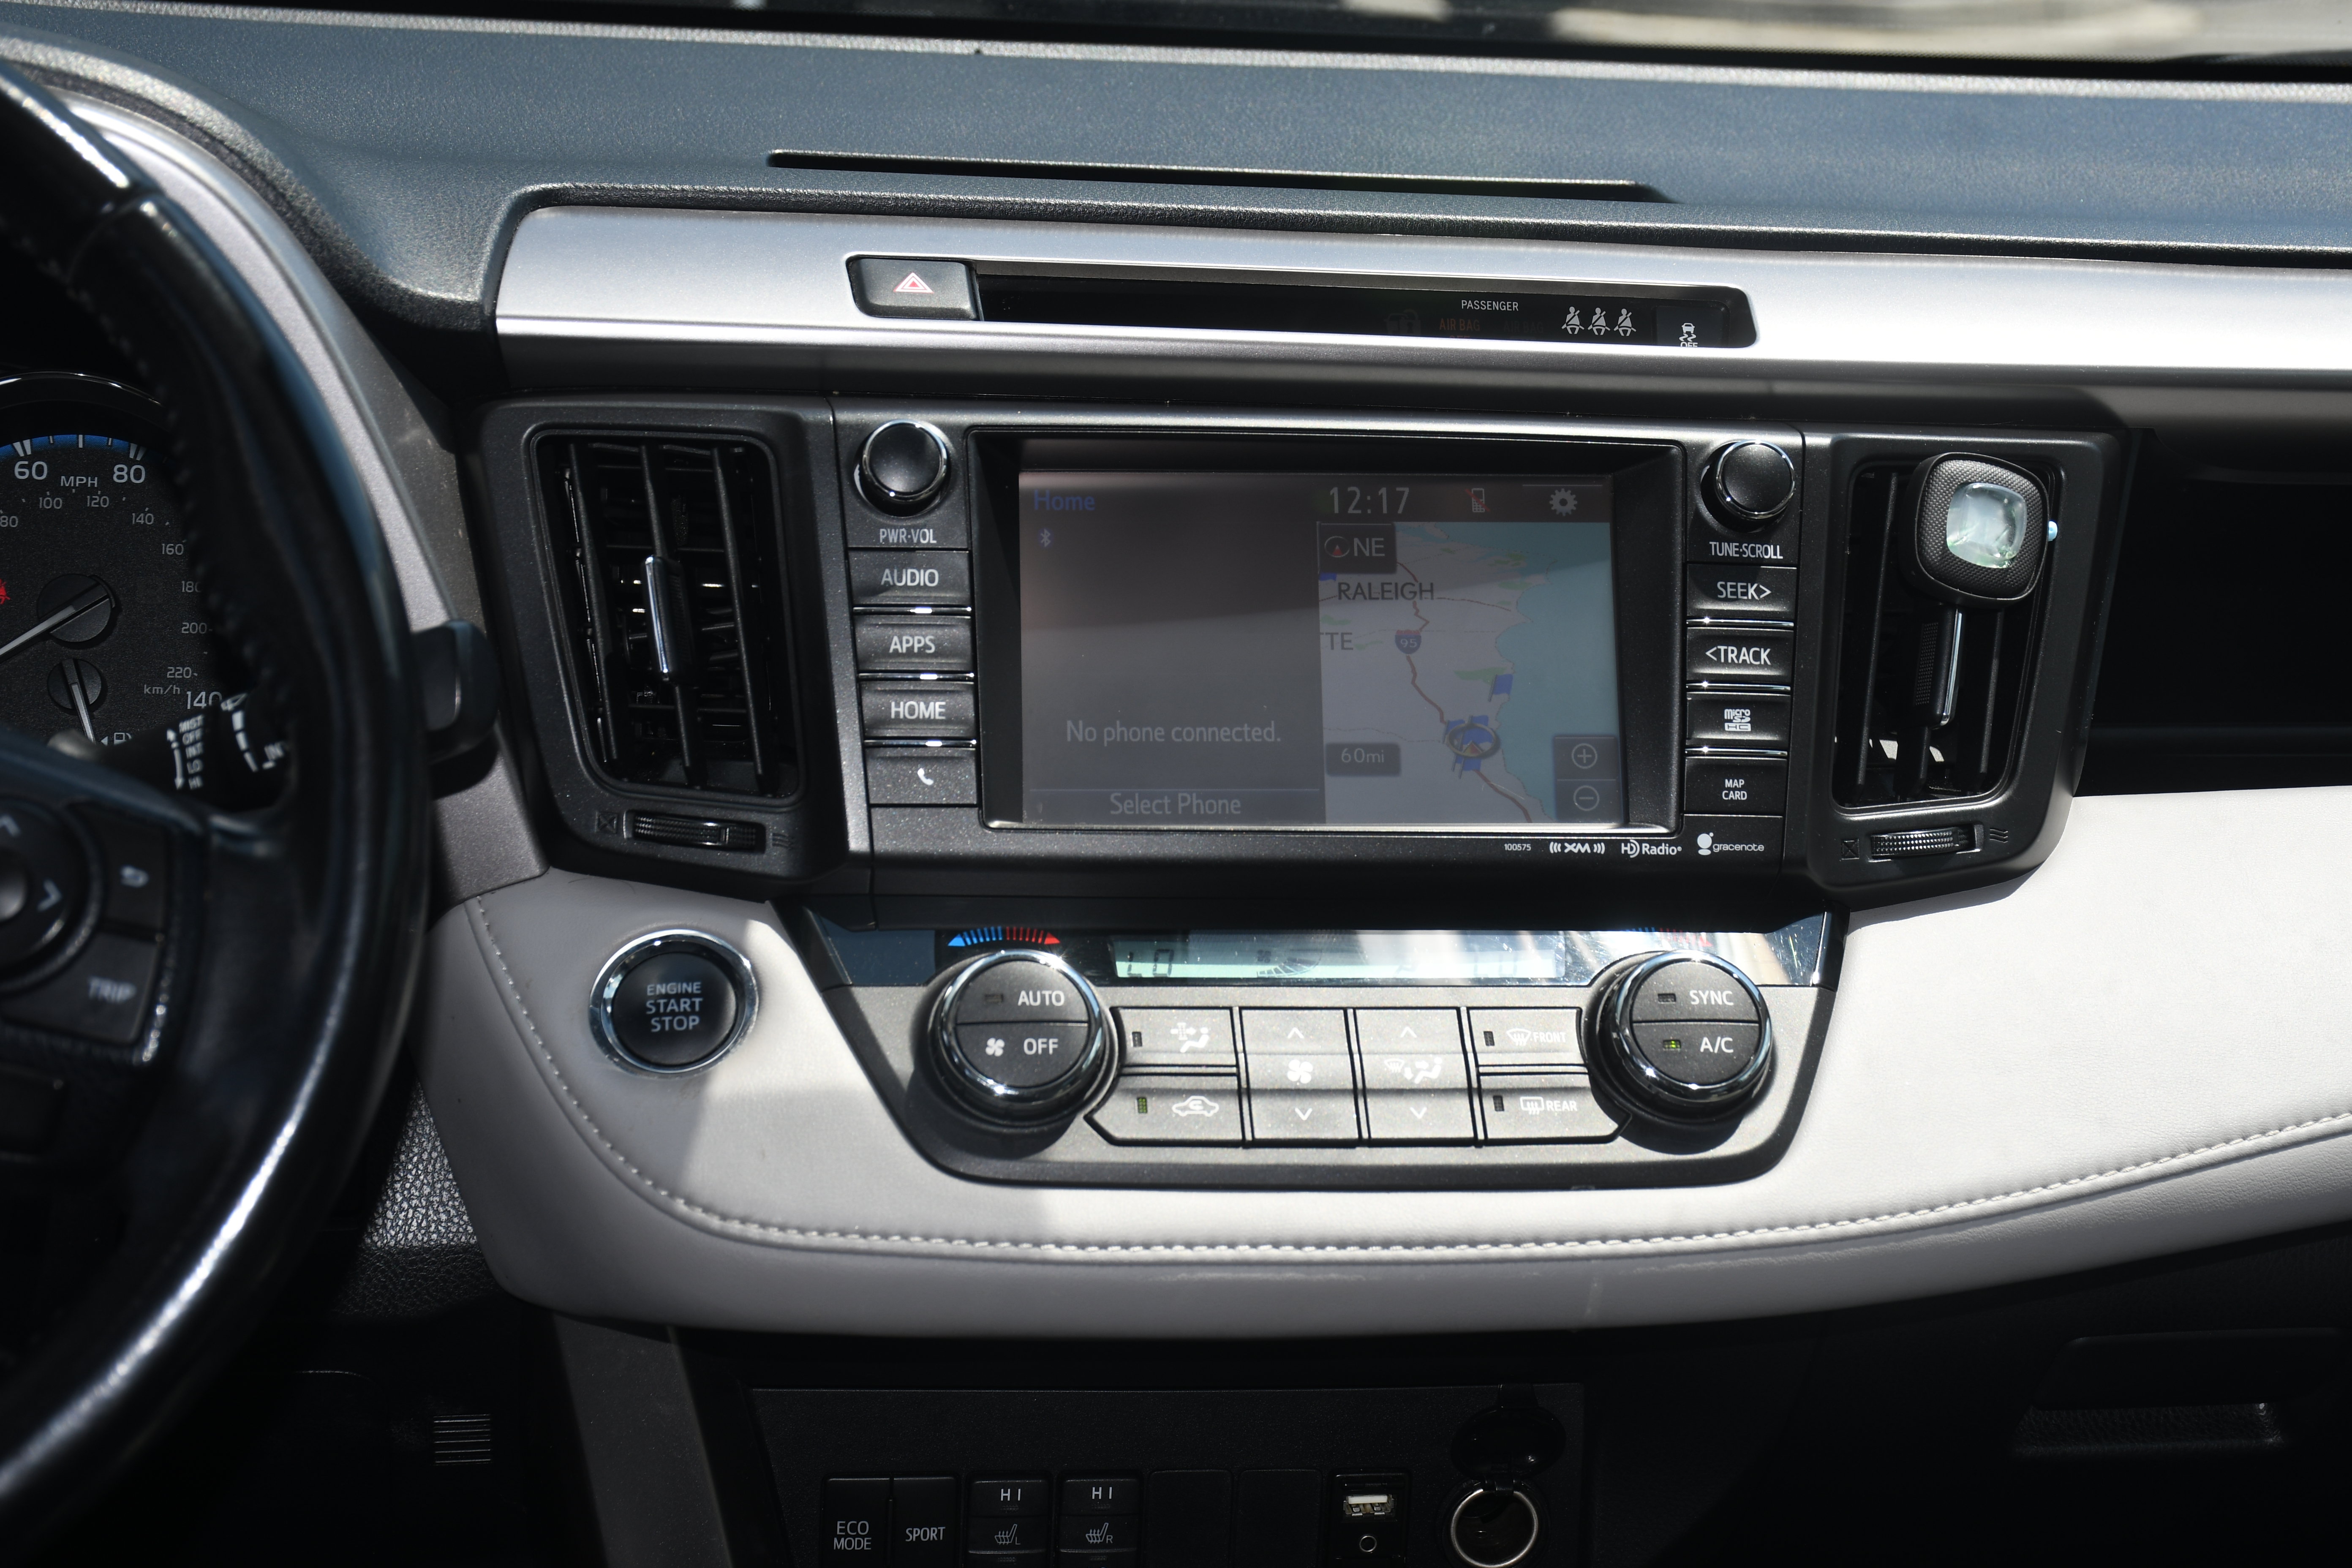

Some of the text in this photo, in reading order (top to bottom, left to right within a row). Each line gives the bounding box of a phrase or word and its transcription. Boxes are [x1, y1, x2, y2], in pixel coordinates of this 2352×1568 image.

[1461, 299, 1519, 312] PASSENGER
[1439, 318, 1481, 332] AIR BAG
[14, 460, 48, 480] 60
[112, 464, 146, 484] 80
[60, 476, 98, 487] MPH
[39, 497, 62, 509] 100
[87, 495, 109, 508] 120
[1034, 489, 1095, 511] Home
[1329, 487, 1409, 514] 12:17
[131, 512, 154, 525] 140
[161, 543, 184, 556] 160
[1354, 537, 1386, 557] NE
[881, 569, 939, 588] AUDIO
[1337, 582, 1434, 601] RALEIGH
[181, 622, 207, 634] 200
[889, 635, 936, 654] APPS
[1320, 632, 1353, 651] TE
[1400, 638, 1417, 648] 95
[166, 667, 192, 679] 220
[144, 683, 180, 695] km/h
[890, 701, 946, 720] HOME
[178, 714, 204, 734] MIST
[182, 727, 203, 745] OFF
[1066, 720, 1281, 747] No phone connected.
[185, 741, 204, 759] INT
[1341, 748, 1385, 764] 60mi
[187, 759, 204, 774] LO
[1725, 779, 1745, 788] MAP
[1722, 790, 1748, 800] CARD
[1110, 793, 1241, 815] Select Phone
[1504, 843, 1531, 851] 100575
[1713, 843, 1764, 854] gracenote
[89, 977, 136, 1004] TRIP
[647, 981, 702, 996] ENGINE
[645, 997, 703, 1014] START
[1017, 990, 1065, 1007] AUTO
[1689, 990, 1734, 1006] SYNC
[651, 1015, 700, 1032] STOP
[1533, 1032, 1566, 1043] FRONT
[1700, 1036, 1734, 1054] A/C
[1023, 1037, 1059, 1055] OFF
[1546, 1100, 1578, 1111] REAR
[836, 1520, 869, 1536] ECO
[905, 1526, 946, 1542] SPORT
[833, 1537, 871, 1551] MODE
[1015, 1536, 1021, 1545] L
[1106, 1535, 1113, 1544] R
